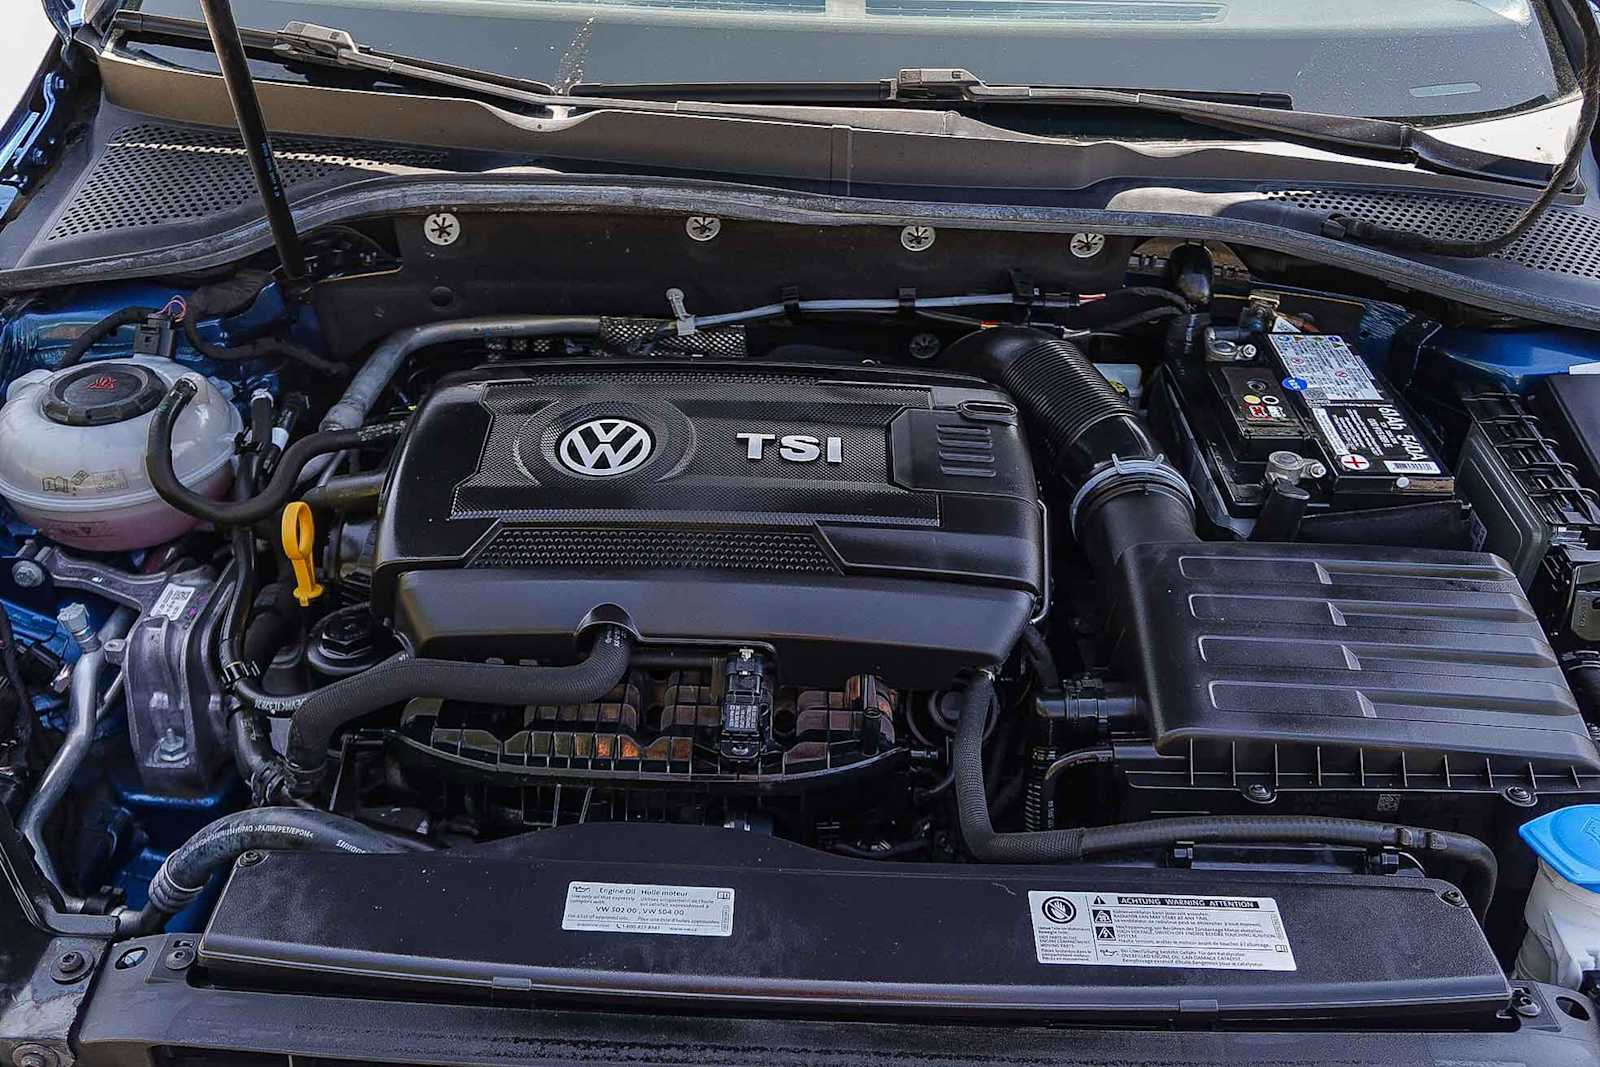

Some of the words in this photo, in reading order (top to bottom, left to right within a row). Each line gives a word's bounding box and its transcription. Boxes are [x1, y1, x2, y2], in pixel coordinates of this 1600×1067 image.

[559, 419, 651, 476] VW
[736, 433, 843, 464] TSI
[599, 887, 625, 895] Engine
[1121, 897, 1161, 906] ACHTUNG
[1165, 899, 1206, 907] WARNING
[1209, 900, 1254, 908] ATTENTION
